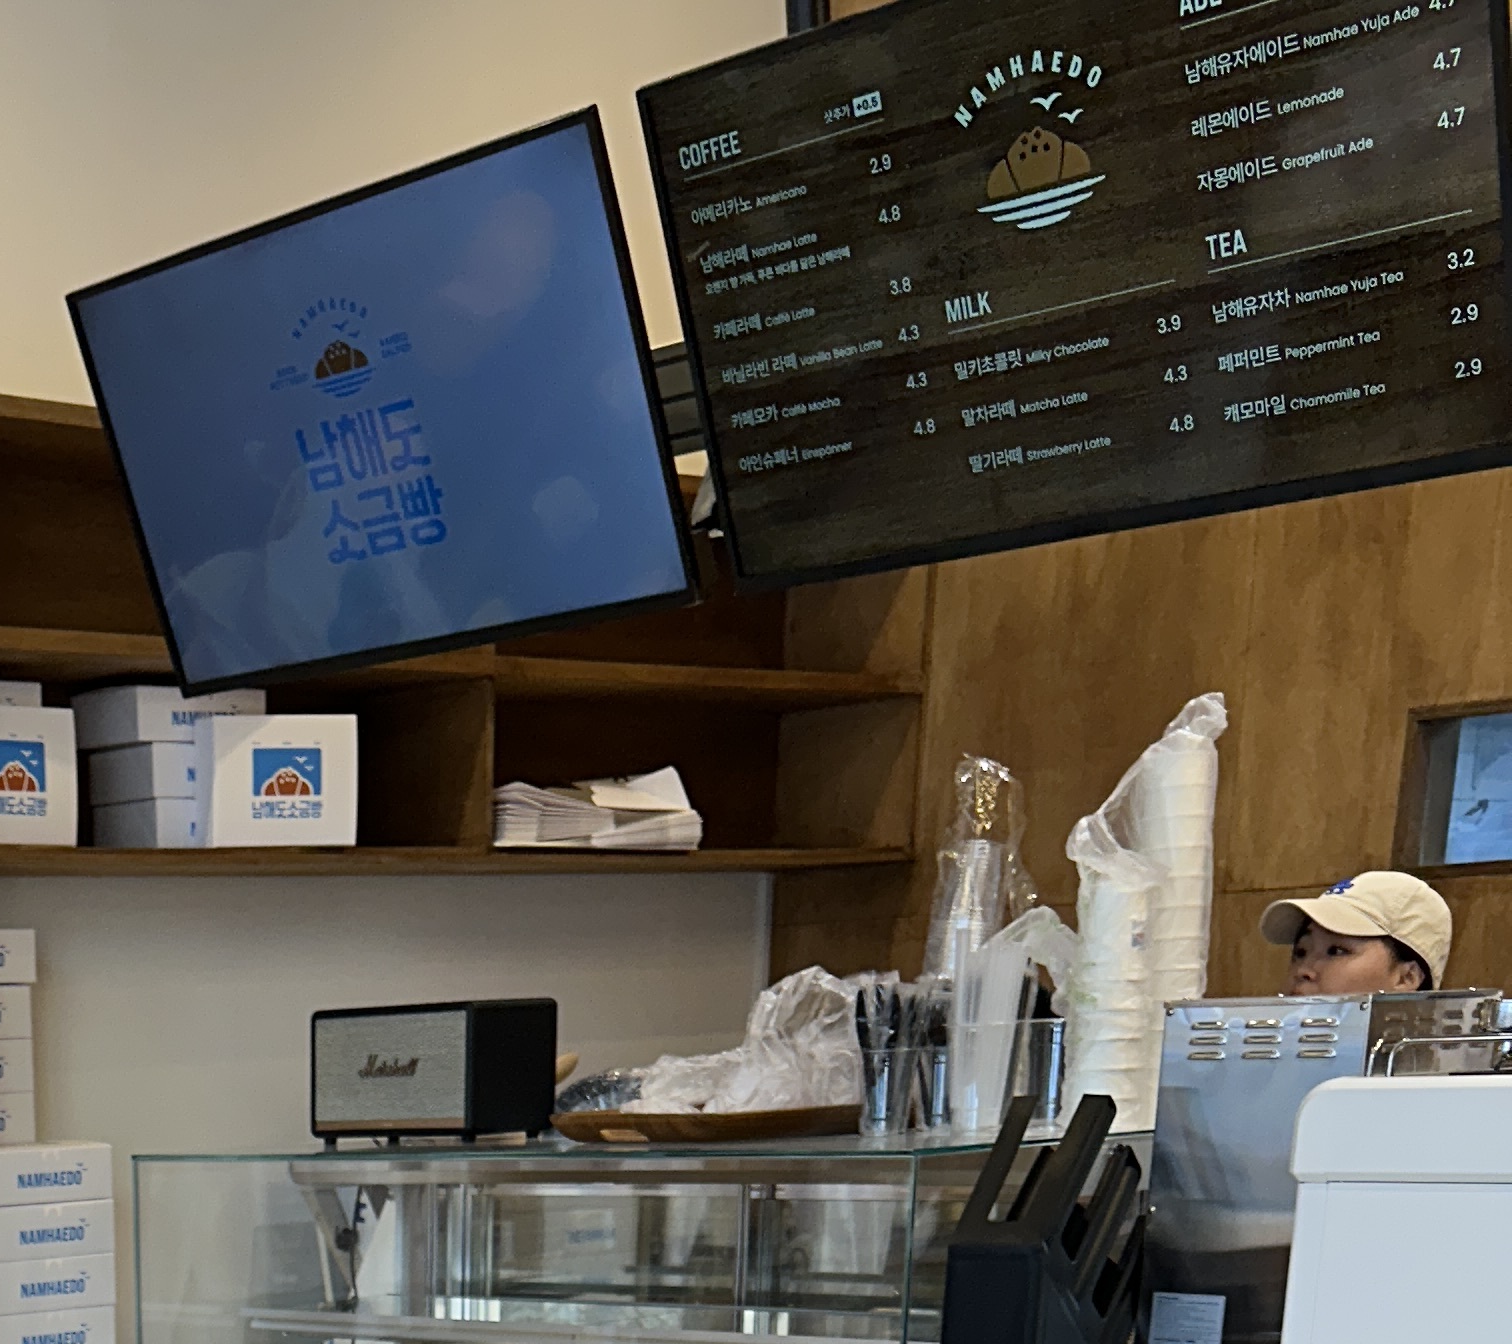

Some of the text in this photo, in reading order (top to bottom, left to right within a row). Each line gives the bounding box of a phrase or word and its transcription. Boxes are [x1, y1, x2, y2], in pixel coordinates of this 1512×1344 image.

[1184, 32, 1301, 84] 남해유자에이드
[1303, 23, 1359, 50] Namhae
[1360, 13, 1390, 33] Yuja
[1393, 6, 1420, 23] Ade
[856, 96, 878, 111] +0.5
[953, 50, 1102, 128] NAMHAEDO
[1191, 47, 1462, 137] 레몬에이드 Lemonade 4.7
[679, 130, 741, 170] COFFEE
[1196, 106, 1465, 192] 자몽에이드 Grapefruit Ade 4.7
[691, 154, 892, 226] 아메리카노 Americano 2.9
[752, 240, 792, 258] Namhae
[793, 232, 818, 248] Latte
[878, 204, 901, 224] 4.8
[1205, 228, 1248, 261] TEA
[791, 307, 816, 321] Latte
[889, 276, 912, 295] 3.8
[945, 291, 992, 323] MILK
[1211, 248, 1475, 323] 남해유자차 Namhae Yuja Tea 3.2
[721, 360, 770, 384] 바닐라빈
[771, 352, 798, 372] 라떼
[858, 339, 883, 353] Latte
[898, 324, 920, 342] 4.3
[954, 314, 1182, 381] 밀키초콜릿 Milky Chocolate 3.9
[1217, 304, 1479, 374] 페퍼민트 Peppermint Tea 2.9
[731, 403, 778, 429] 카페모카
[808, 397, 841, 412] Mocha
[906, 371, 928, 389] 4.3
[961, 365, 1188, 427] 말차라떼 Matcha Latte 4.3
[1224, 357, 1483, 423] 캐모마일 Chamomile Tea 2.9
[295, 398, 431, 492] 남해도
[739, 446, 799, 473] 아인슈페너
[914, 418, 936, 435] 4.8
[968, 414, 1194, 474] 딸기라떼 Strawberry Latte 4.8
[322, 474, 447, 565] 소금빵
[17, 1170, 83, 1189] NAMHAEDO
[19, 1226, 84, 1246] NAMHAEDO
[20, 1277, 85, 1298] NAMHAEDO
